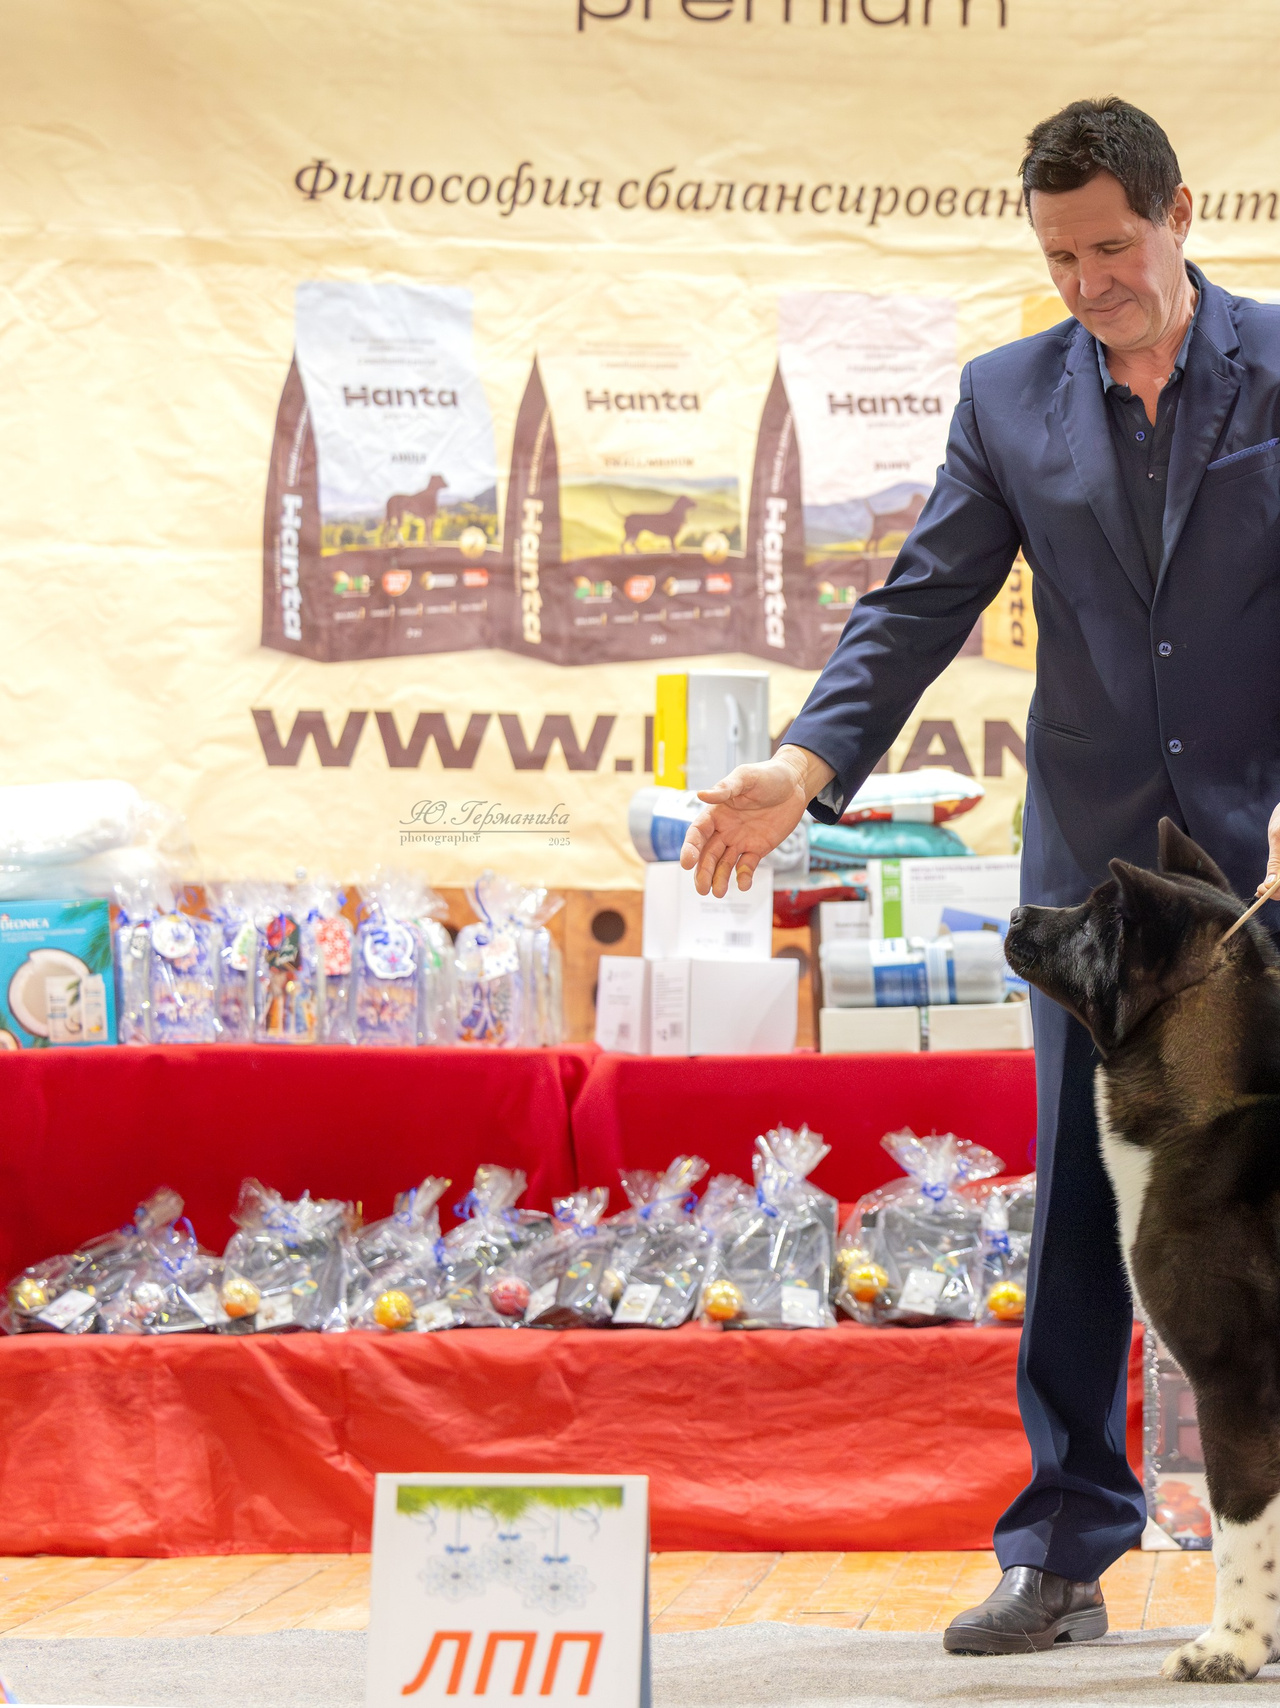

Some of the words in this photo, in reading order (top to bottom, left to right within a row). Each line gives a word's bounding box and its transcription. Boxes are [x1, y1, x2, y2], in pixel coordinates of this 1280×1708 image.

[294, 157, 603, 217] Философия
[342, 385, 459, 408] Hanta
[585, 388, 701, 412] Hanta
[827, 391, 942, 416] Hanta
[280, 493, 303, 642] Hanta
[520, 498, 544, 645] Hanta
[763, 496, 788, 650] Hanta
[401, 1630, 604, 1697] ЛПП
